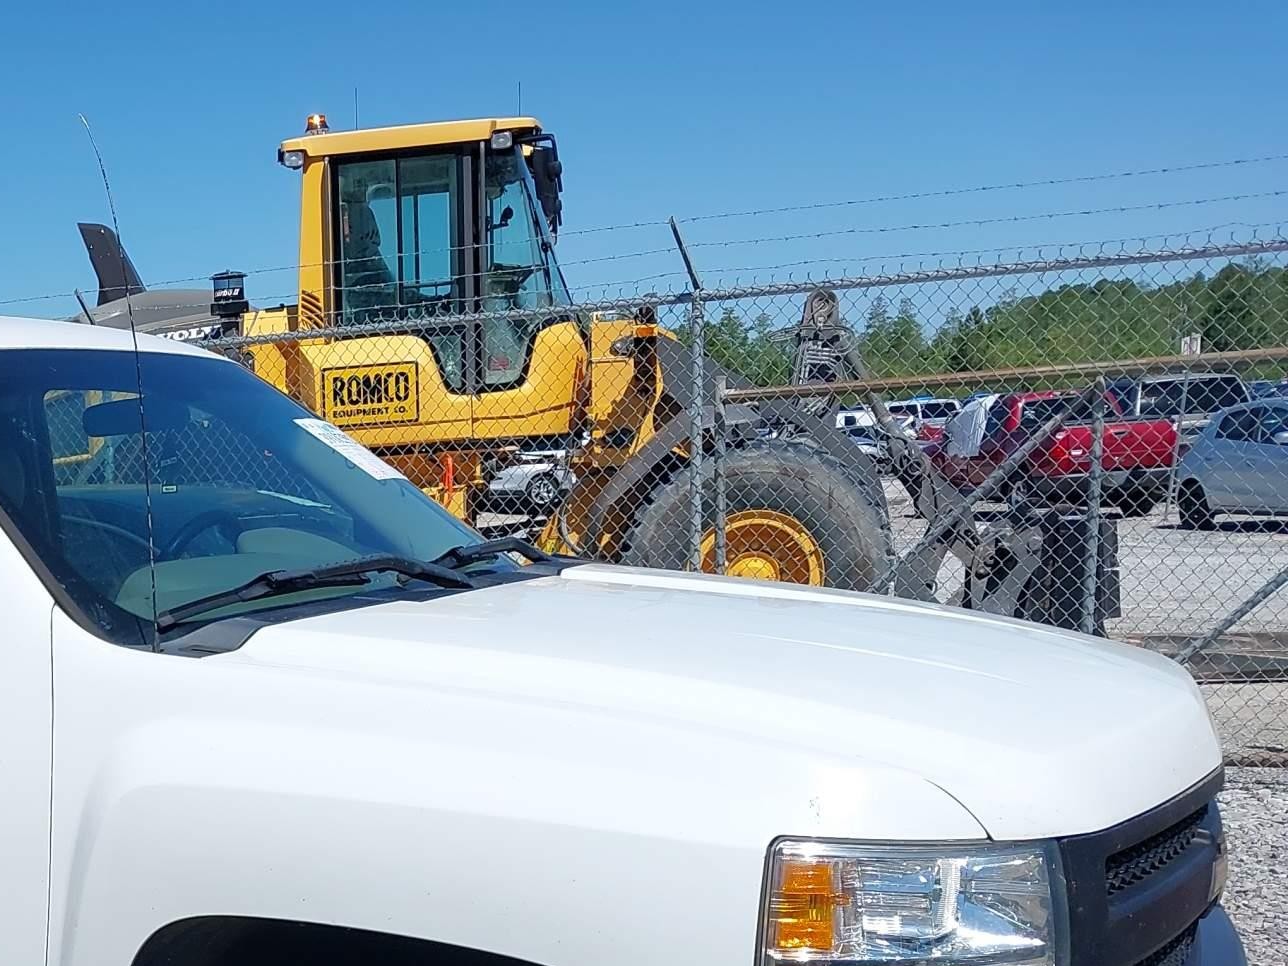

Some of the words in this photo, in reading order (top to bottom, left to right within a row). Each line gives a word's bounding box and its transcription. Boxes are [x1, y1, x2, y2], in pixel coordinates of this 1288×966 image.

[155, 325, 221, 341] VOLV
[332, 372, 410, 407] ROMCO
[333, 407, 389, 418] EQUIPMENT
